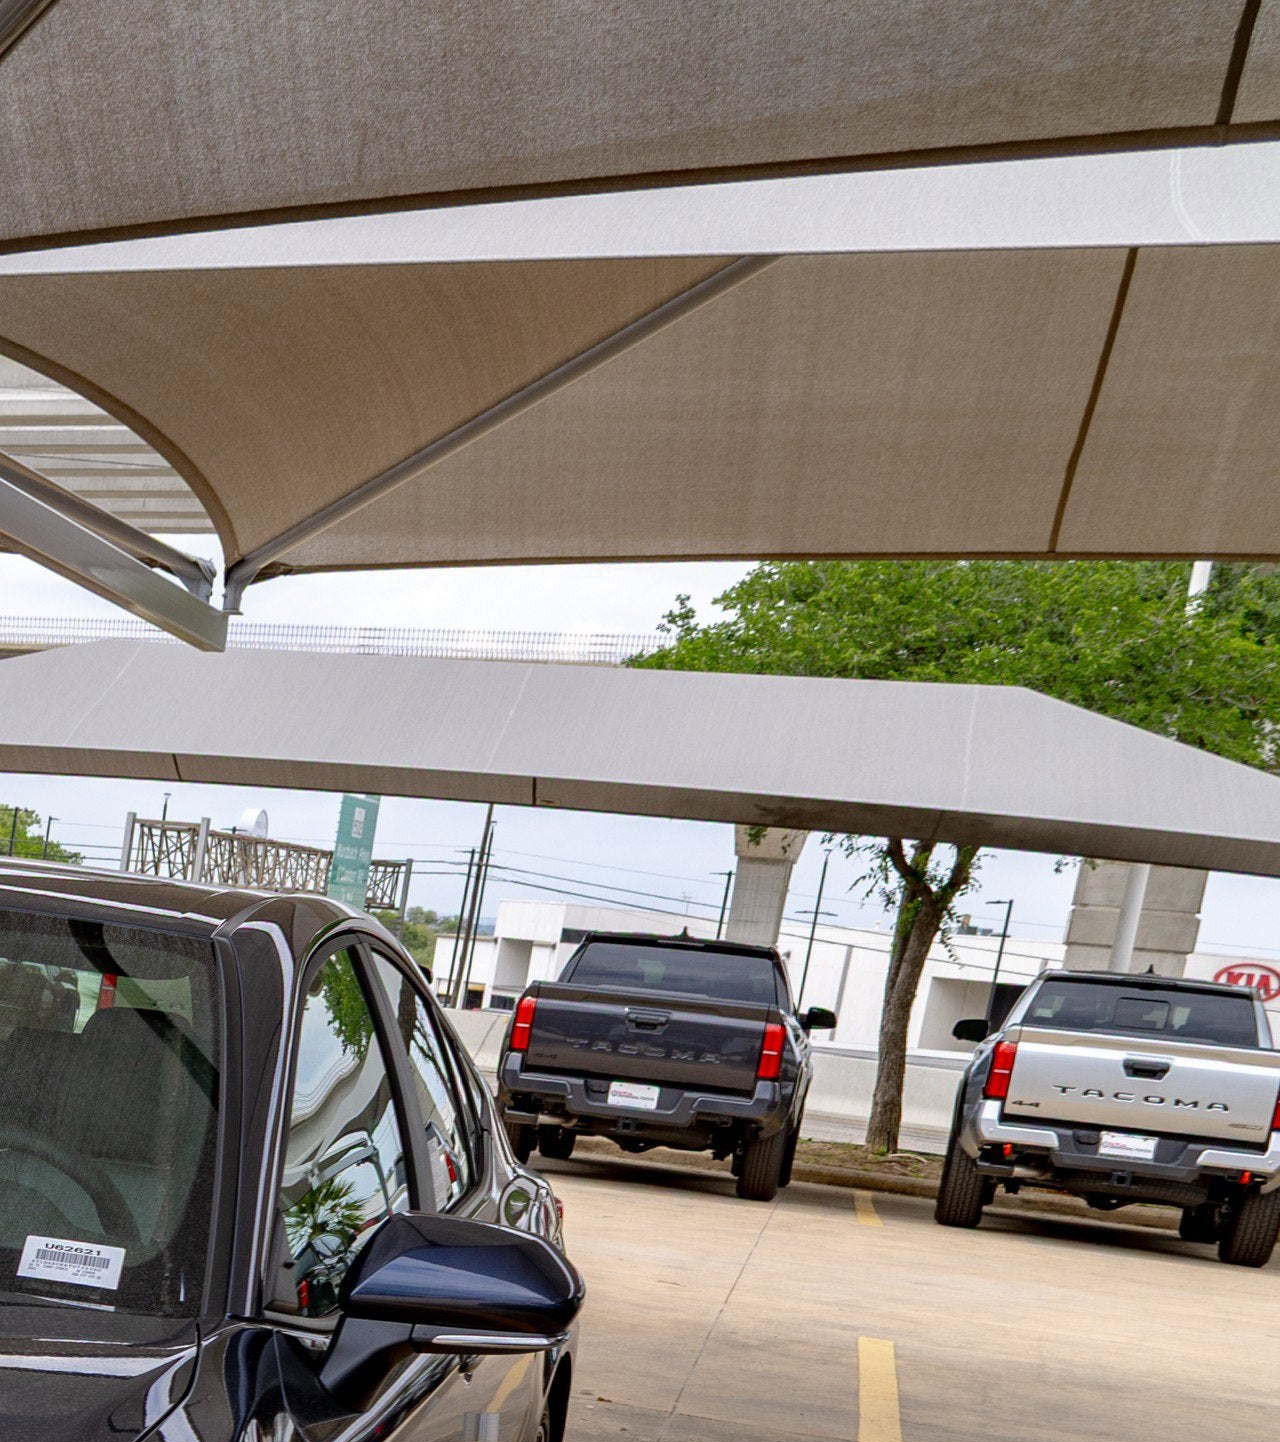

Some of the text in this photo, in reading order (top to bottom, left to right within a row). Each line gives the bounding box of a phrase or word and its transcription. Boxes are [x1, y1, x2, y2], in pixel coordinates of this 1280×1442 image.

[1226, 971, 1271, 996] KIA
[566, 1037, 721, 1065] TACOMA
[1052, 1084, 1229, 1113] TACOMA
[45, 1243, 101, 1256] U62621
